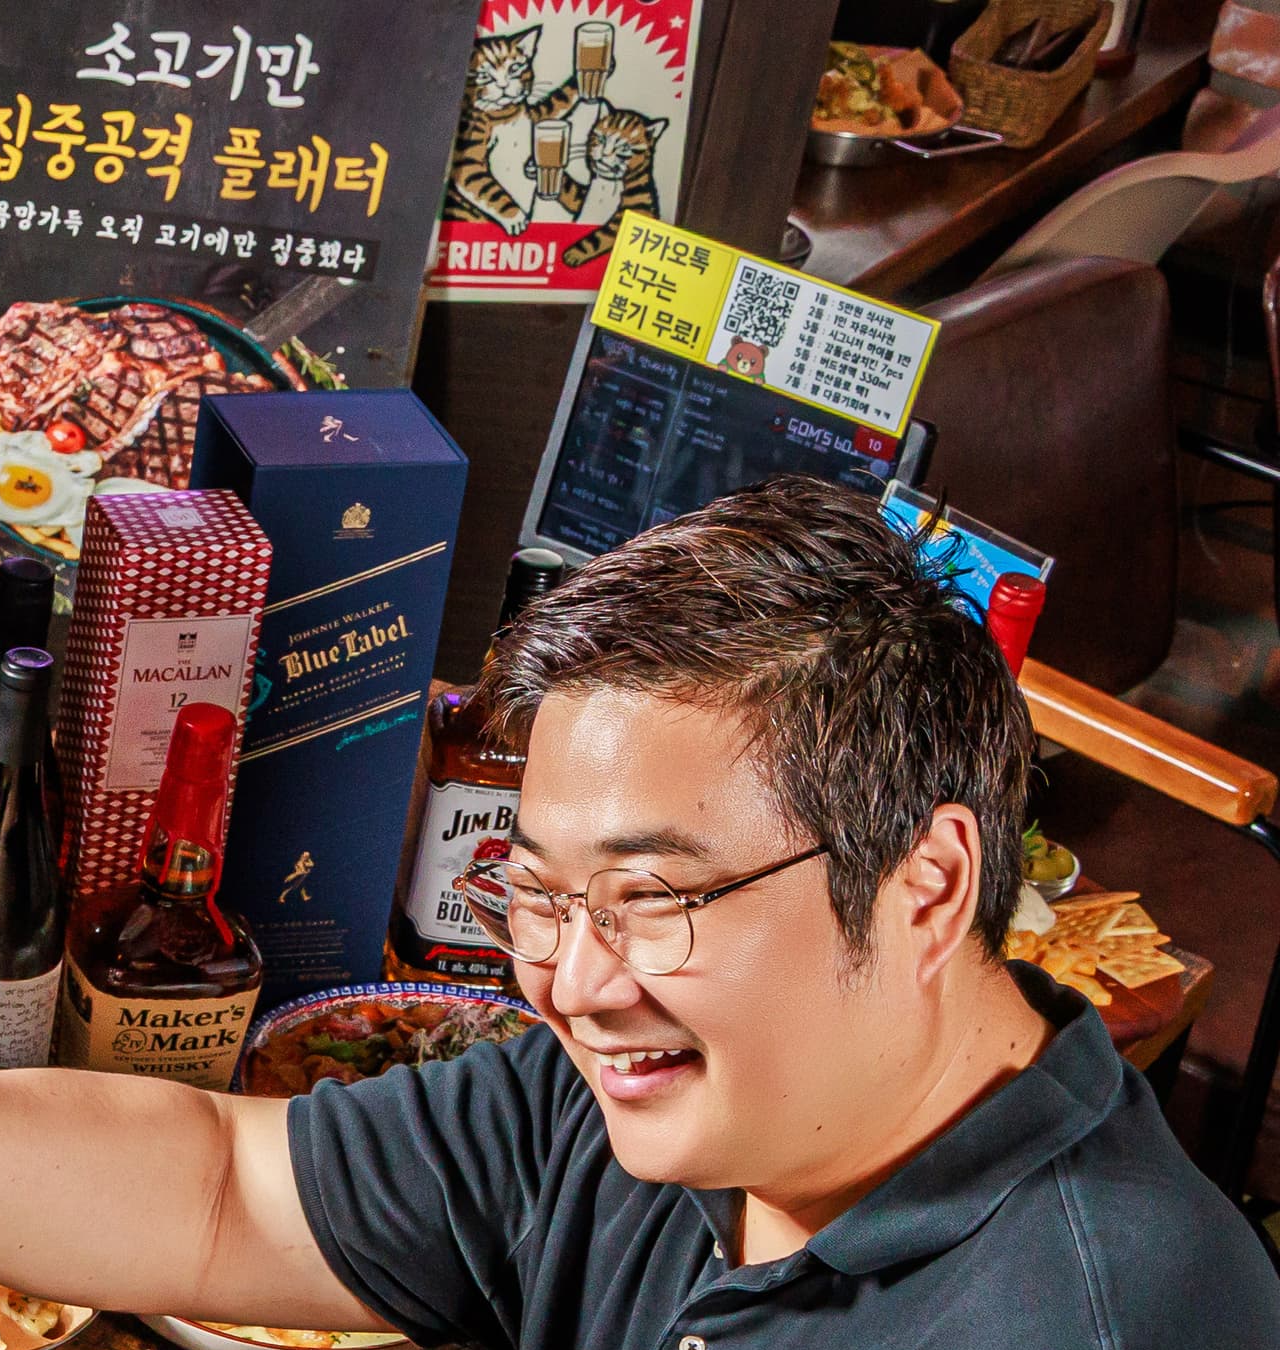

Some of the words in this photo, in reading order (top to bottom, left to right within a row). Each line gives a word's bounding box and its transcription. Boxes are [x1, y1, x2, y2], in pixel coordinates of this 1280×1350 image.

[76, 21, 321, 109] 소고기만
[213, 127, 390, 218] 플래터
[95, 214, 144, 244] 오직
[154, 222, 258, 258] 고기에만
[270, 233, 367, 274] 집중했다
[628, 226, 711, 275] 카카오톡
[618, 260, 677, 303] 친구는
[836, 300, 864, 318] 5만원
[607, 293, 649, 331] 뽑기
[651, 309, 702, 350] 무료!
[859, 371, 892, 391] 330ml
[880, 363, 904, 380] 7pcs
[288, 618, 341, 647] JOHNNIE
[278, 644, 341, 684] Blue
[340, 613, 410, 663] Label
[133, 664, 233, 683] MACALLAN
[170, 692, 188, 708] 12
[442, 808, 492, 842] JIM
[492, 804, 519, 832] B
[436, 900, 474, 922] BOU
[460, 924, 486, 936] WHIS
[117, 1004, 246, 1028] Maker's
[147, 1029, 239, 1052] Mark
[132, 1059, 215, 1073] WHISKY
